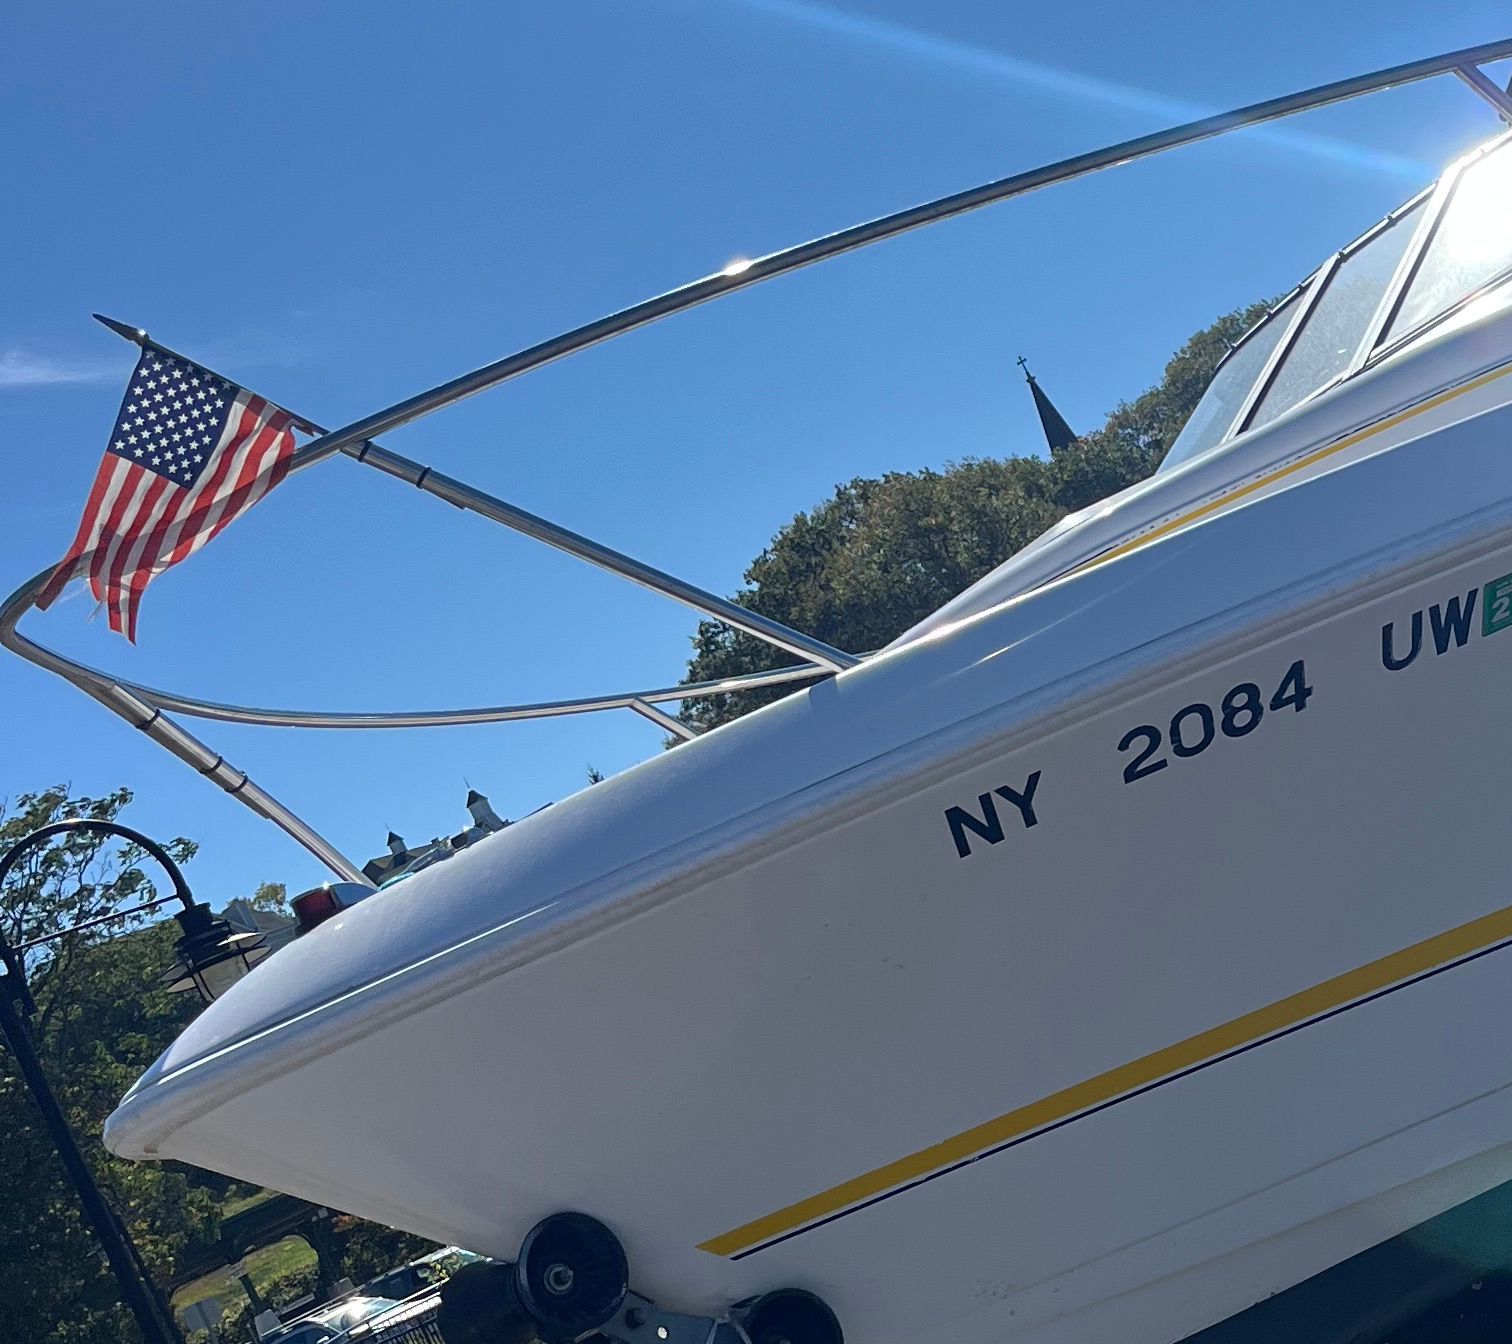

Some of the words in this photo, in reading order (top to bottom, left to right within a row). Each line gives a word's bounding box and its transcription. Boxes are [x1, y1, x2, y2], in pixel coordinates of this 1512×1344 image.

[944, 769, 1042, 858] NY
[1117, 659, 1313, 785] 2084
[1381, 588, 1478, 672] UW
